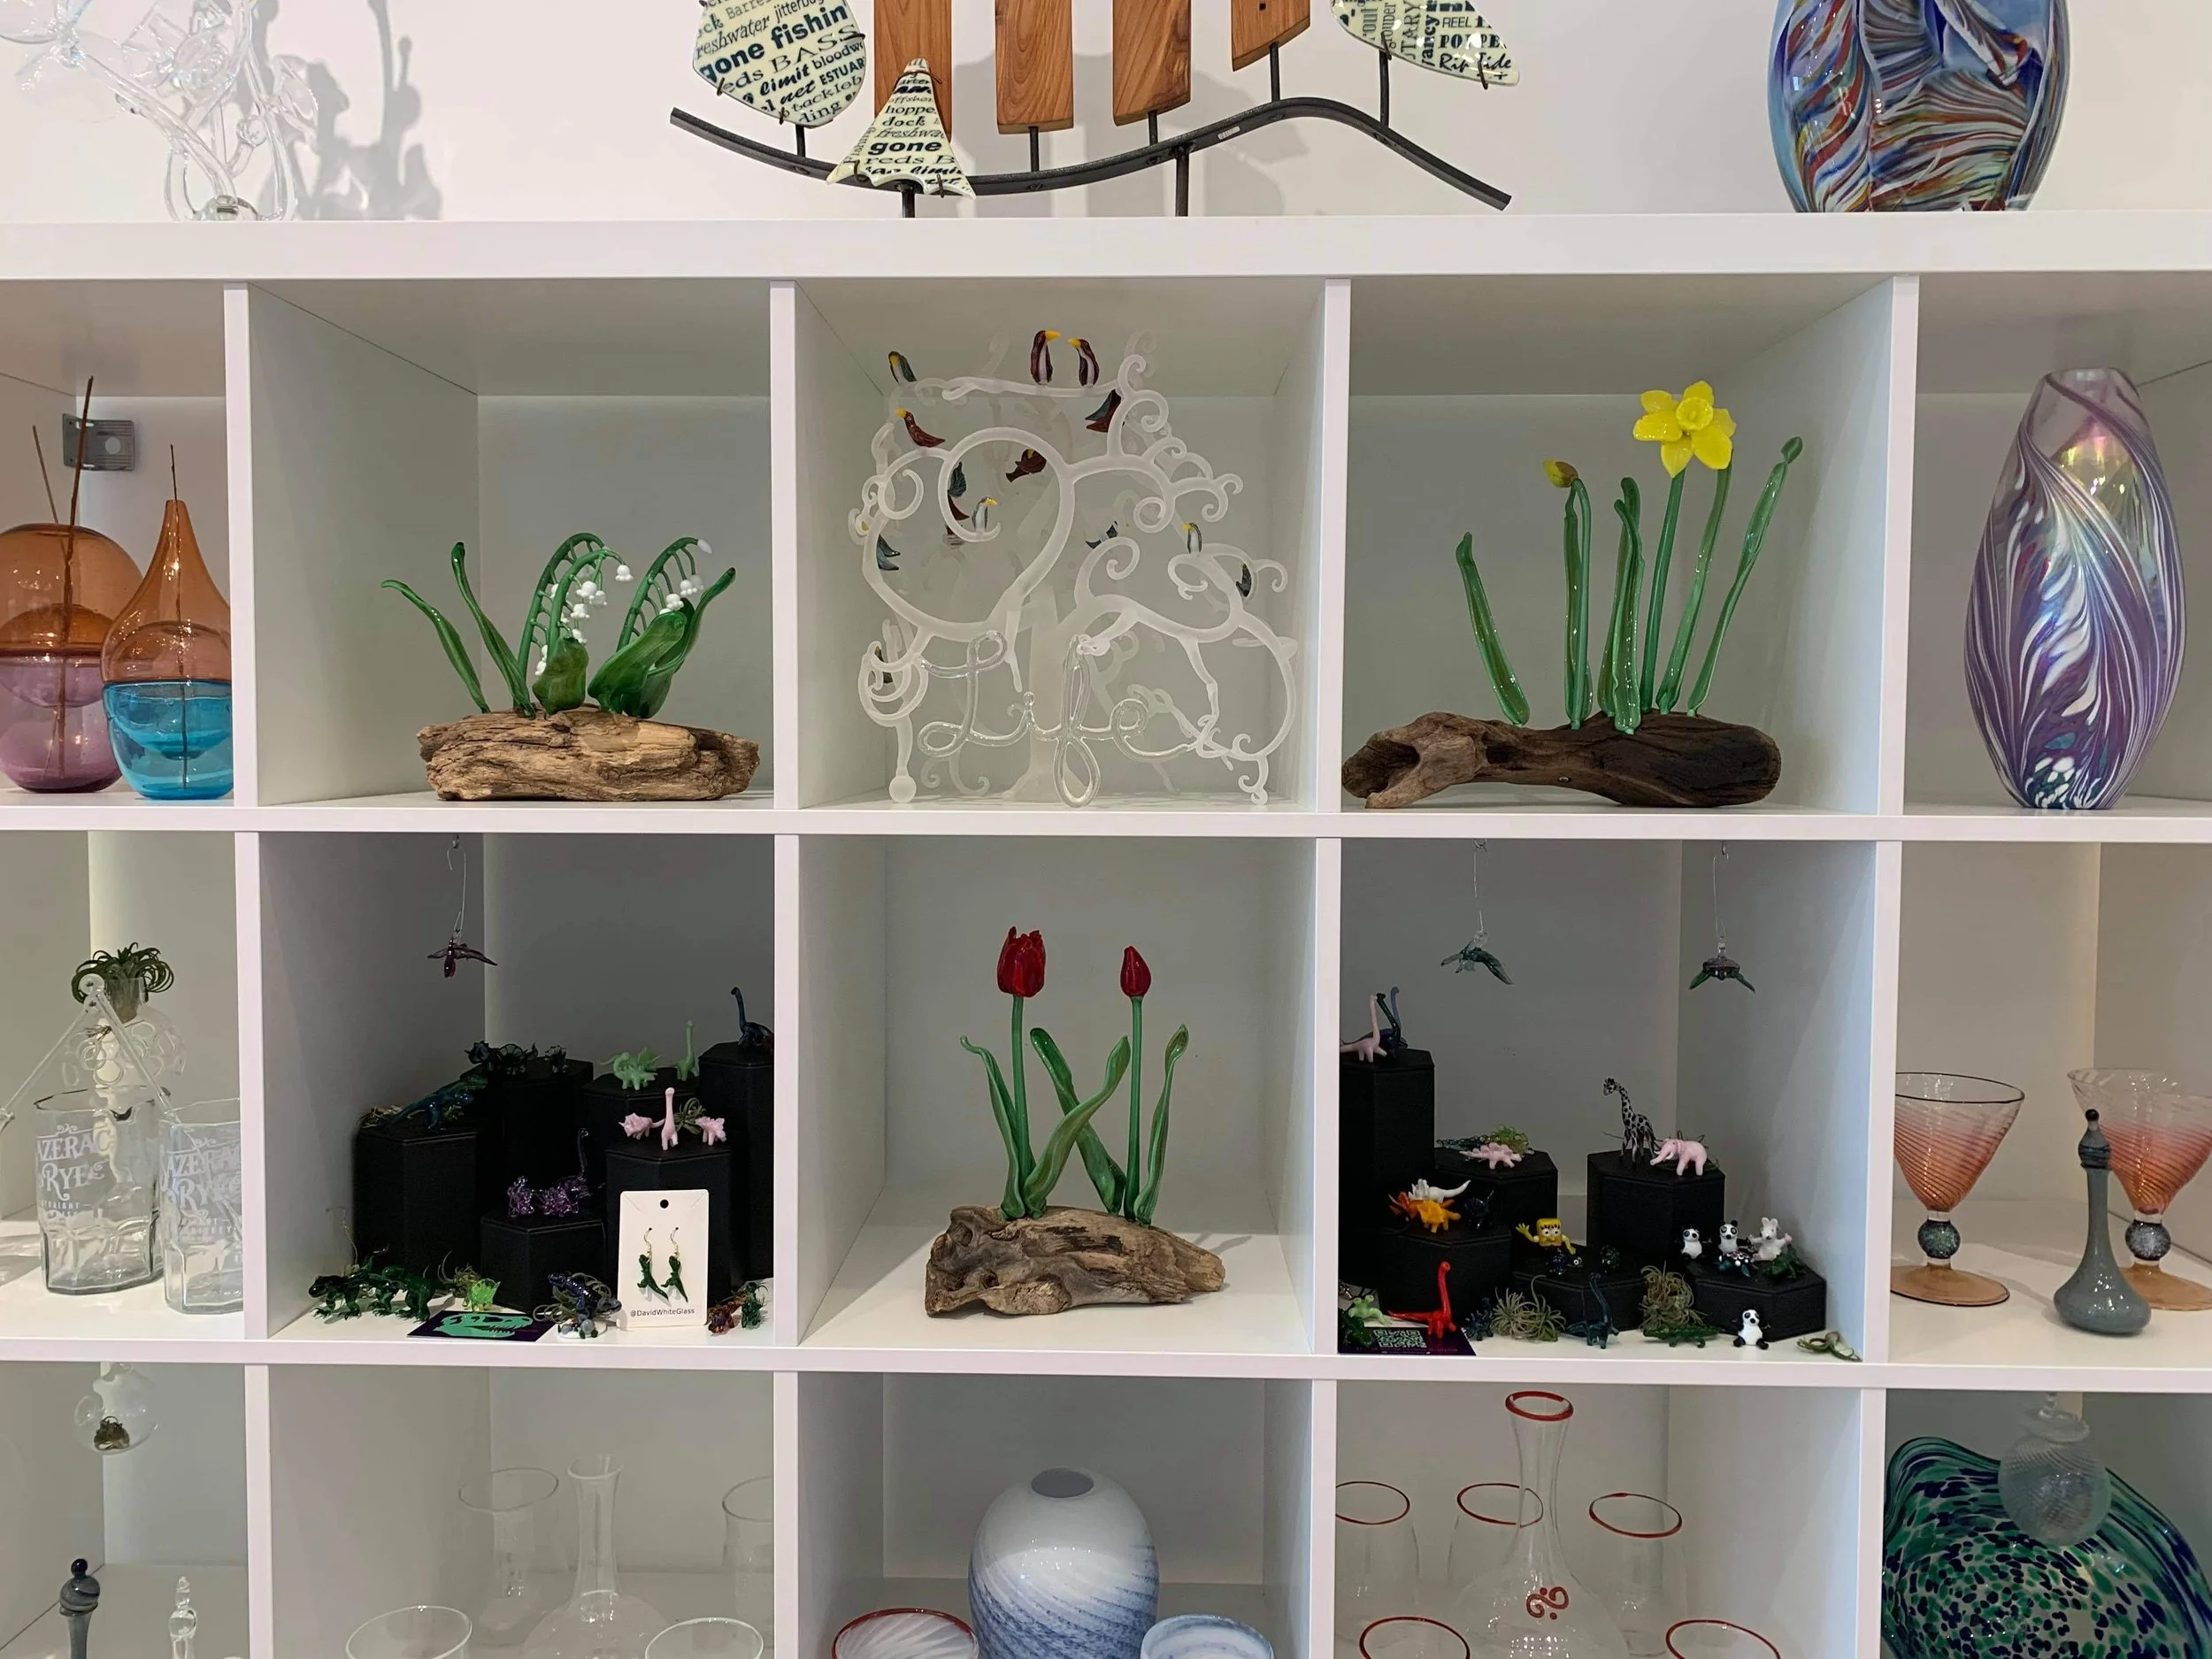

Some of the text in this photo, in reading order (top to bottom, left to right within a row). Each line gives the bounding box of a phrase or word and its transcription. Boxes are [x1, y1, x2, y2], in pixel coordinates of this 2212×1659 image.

[726, 0, 772, 19] Barre
[1361, 7, 1378, 41] out
[1442, 17, 1471, 28] REEL
[696, 16, 770, 59] reshwater
[700, 42, 765, 82] gone
[721, 24, 859, 93] eds BASS
[759, 64, 793, 96] limit
[819, 58, 865, 86] ESTUAR
[885, 105, 936, 115] hoppe
[882, 116, 926, 127] dock
[868, 142, 942, 156] gone
[865, 155, 924, 165] reds
[630, 1308, 695, 1317] @DavidWhiteGlass
